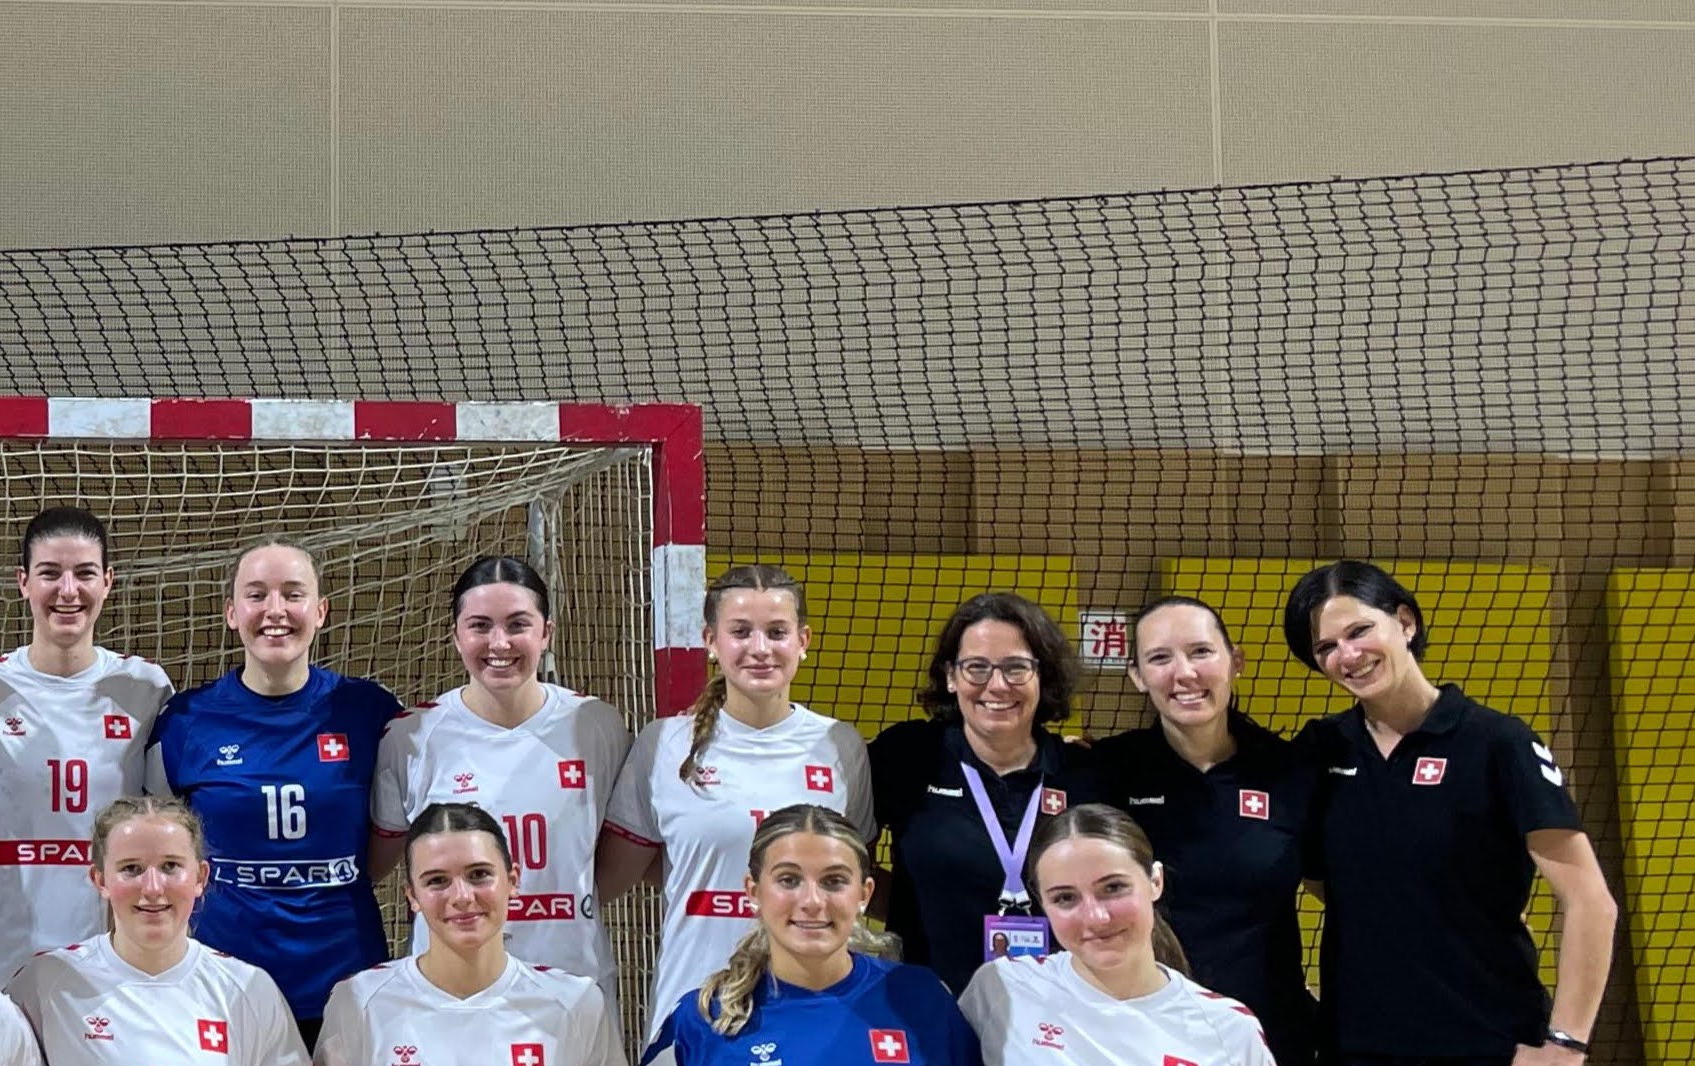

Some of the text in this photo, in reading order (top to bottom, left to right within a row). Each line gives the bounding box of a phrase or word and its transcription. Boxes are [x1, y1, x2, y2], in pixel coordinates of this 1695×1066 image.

[1090, 618, 1126, 656] 消
[47, 759, 88, 813] 19
[261, 783, 307, 840] 16
[17, 843, 93, 862] SPA
[502, 813, 548, 870] 10
[236, 865, 330, 884] SPAR
[508, 898, 573, 917] PAR
